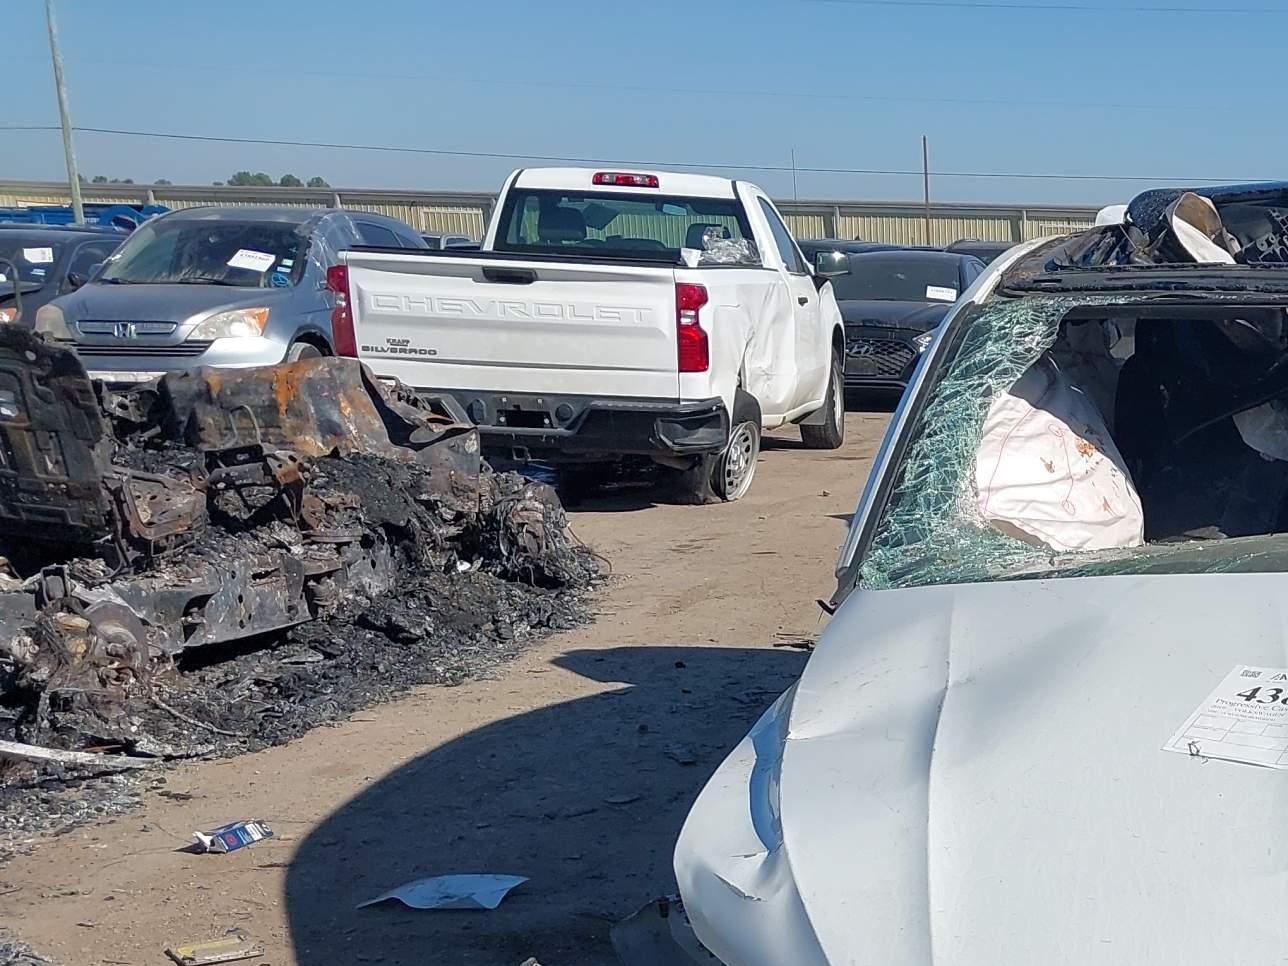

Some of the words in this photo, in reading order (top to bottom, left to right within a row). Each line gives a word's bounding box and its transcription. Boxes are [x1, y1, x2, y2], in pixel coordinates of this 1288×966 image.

[370, 293, 653, 323] CHEVROLET
[361, 345, 437, 356] SILVERADO
[1215, 698, 1271, 712] Progressive
